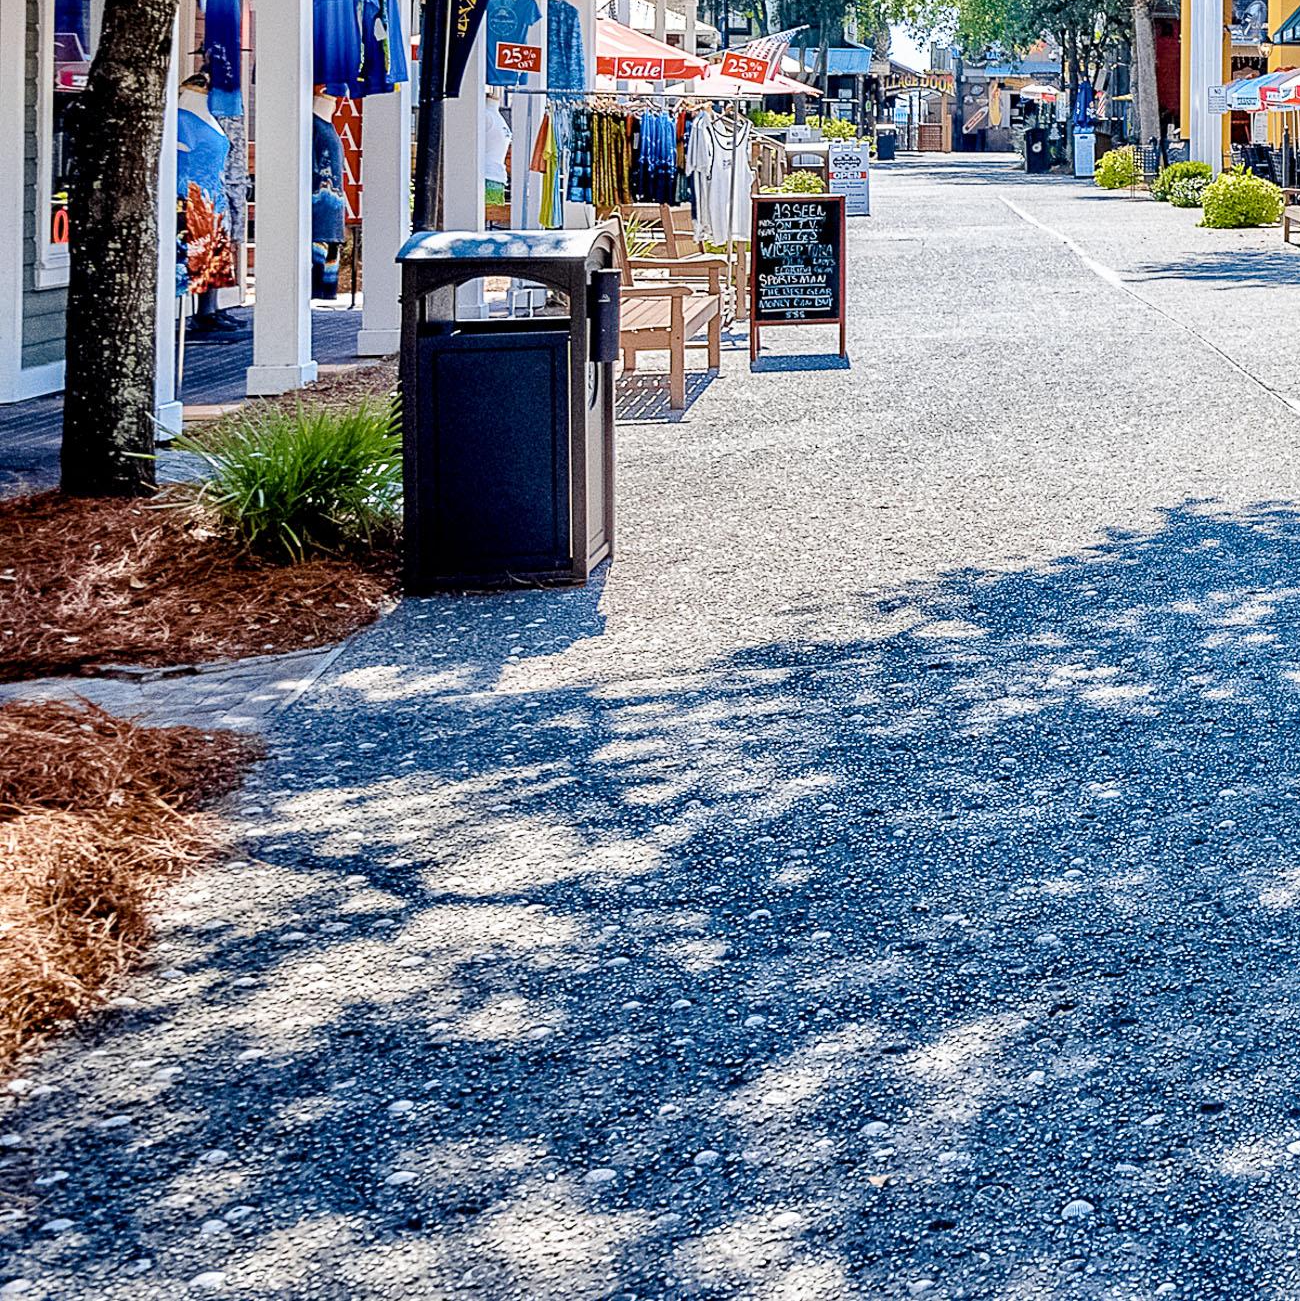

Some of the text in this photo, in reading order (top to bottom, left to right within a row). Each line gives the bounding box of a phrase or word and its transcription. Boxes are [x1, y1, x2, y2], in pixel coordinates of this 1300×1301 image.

[502, 47, 537, 65] 25%
[518, 61, 534, 69] OFF
[619, 61, 661, 77] Sale
[728, 58, 763, 73] 25%
[741, 71, 760, 79] OFF
[921, 73, 956, 95] DOOR
[793, 204, 826, 218] SEEN
